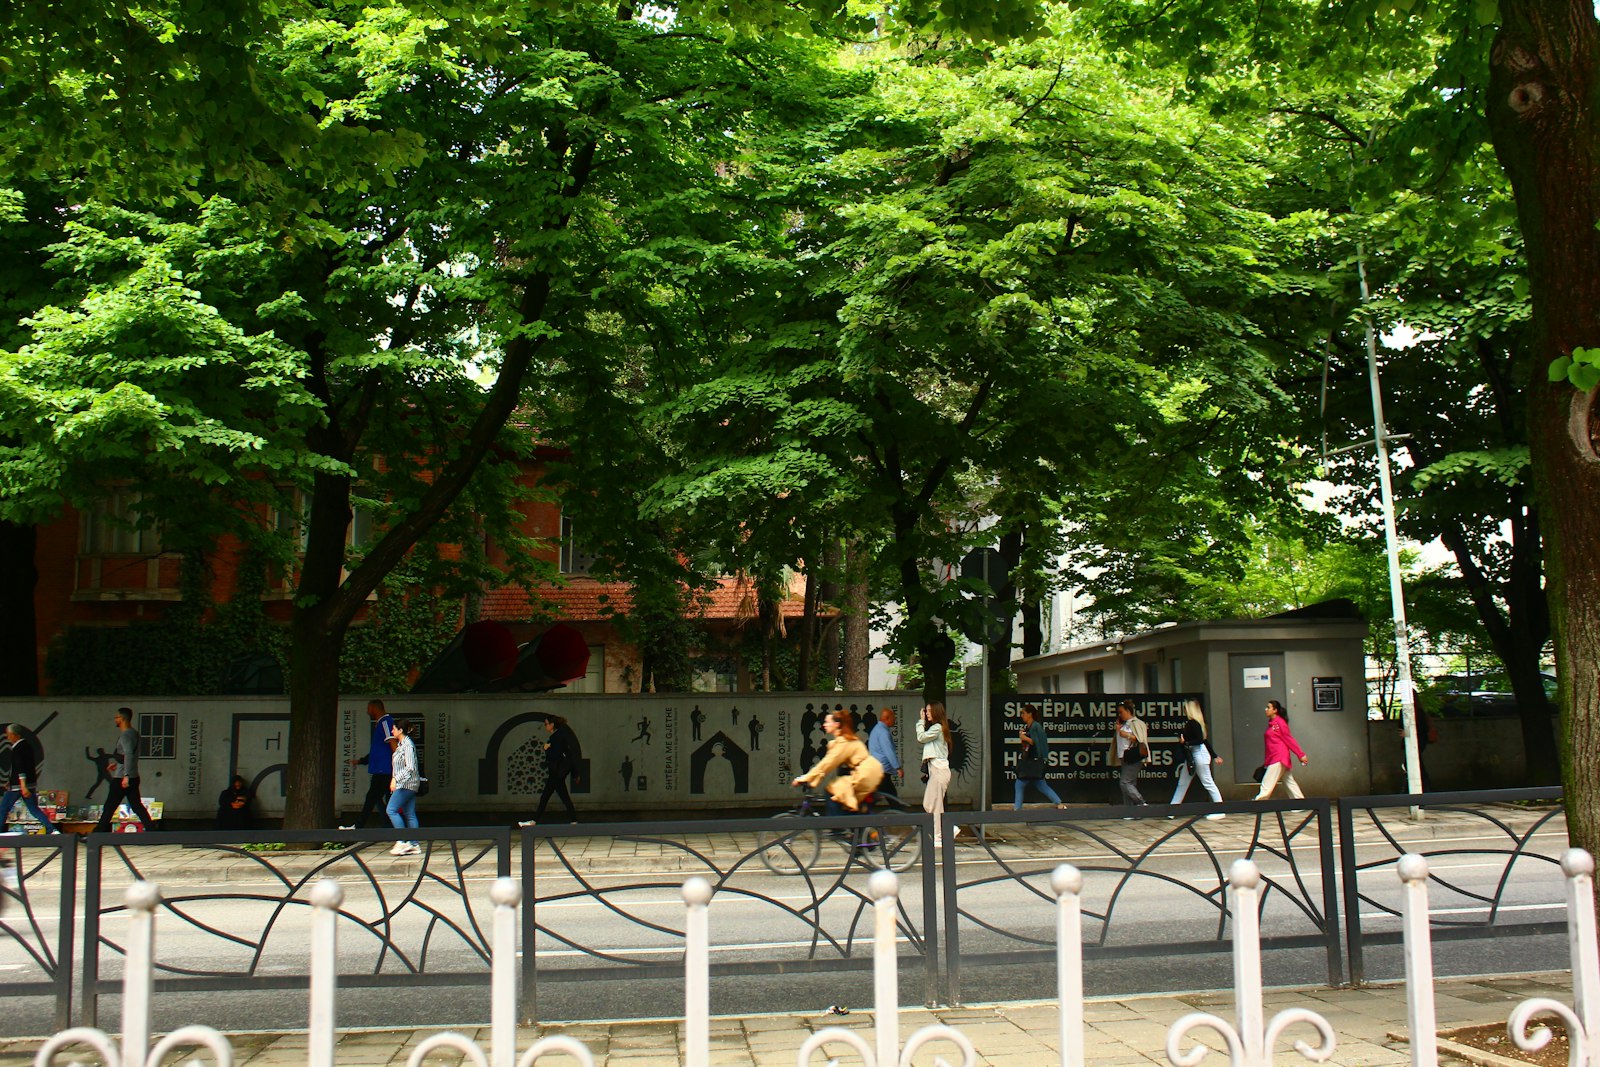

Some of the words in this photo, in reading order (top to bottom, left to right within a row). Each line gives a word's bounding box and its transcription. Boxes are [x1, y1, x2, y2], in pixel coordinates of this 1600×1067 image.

[1089, 701, 1117, 718] ME
[1132, 701, 1186, 717] JETH
[343, 709, 351, 741] GJETHE
[438, 712, 446, 744] LEAVES
[665, 706, 673, 739] GJETHE
[778, 710, 786, 741] LEAVES
[1042, 721, 1095, 733] Përgjimeve
[1096, 721, 1106, 731] të
[1151, 721, 1161, 730] të
[190, 719, 199, 750] LEAVES
[343, 743, 351, 758] ME
[438, 745, 446, 757] OF
[665, 741, 673, 754] ME
[778, 741, 786, 755] OF
[189, 752, 197, 764] OF
[1003, 750, 1070, 767] HSE
[1074, 750, 1101, 767] OF
[437, 759, 446, 788] HOUSE
[778, 756, 786, 785] HOUSE
[1004, 770, 1017, 780] Th
[1067, 770, 1077, 780] of
[1079, 770, 1109, 780] Secret
[188, 766, 197, 795] HOUSE
